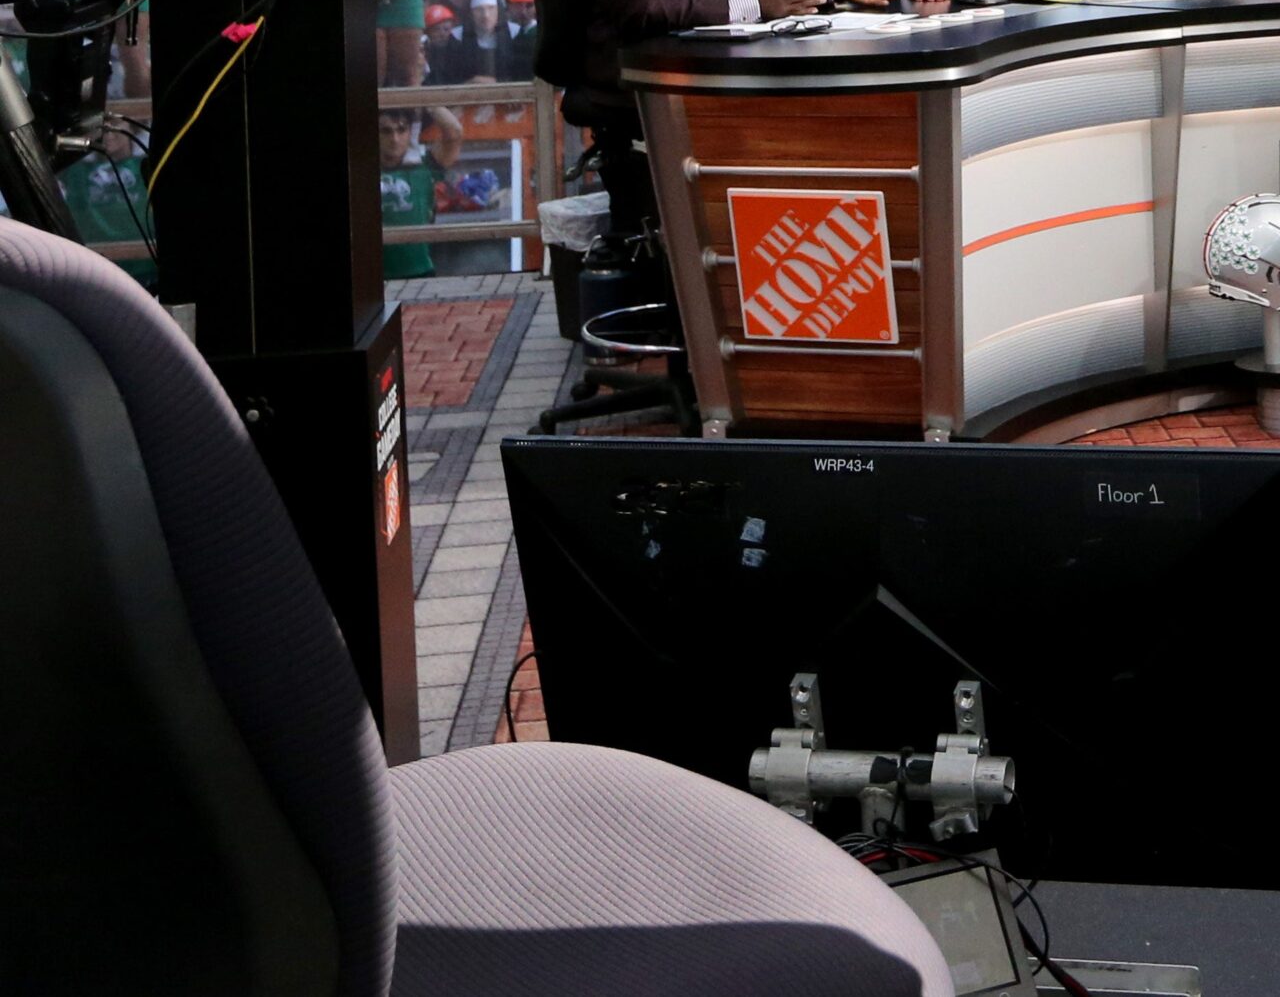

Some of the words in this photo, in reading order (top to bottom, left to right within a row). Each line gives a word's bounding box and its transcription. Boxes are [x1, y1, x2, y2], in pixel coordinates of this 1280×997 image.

[744, 197, 883, 337] HOME
[751, 208, 810, 267] THE
[802, 252, 887, 339] DEPOT
[814, 458, 874, 473] WRP43-4
[1097, 483, 1144, 503] Floor
[1148, 483, 1165, 504] 1
